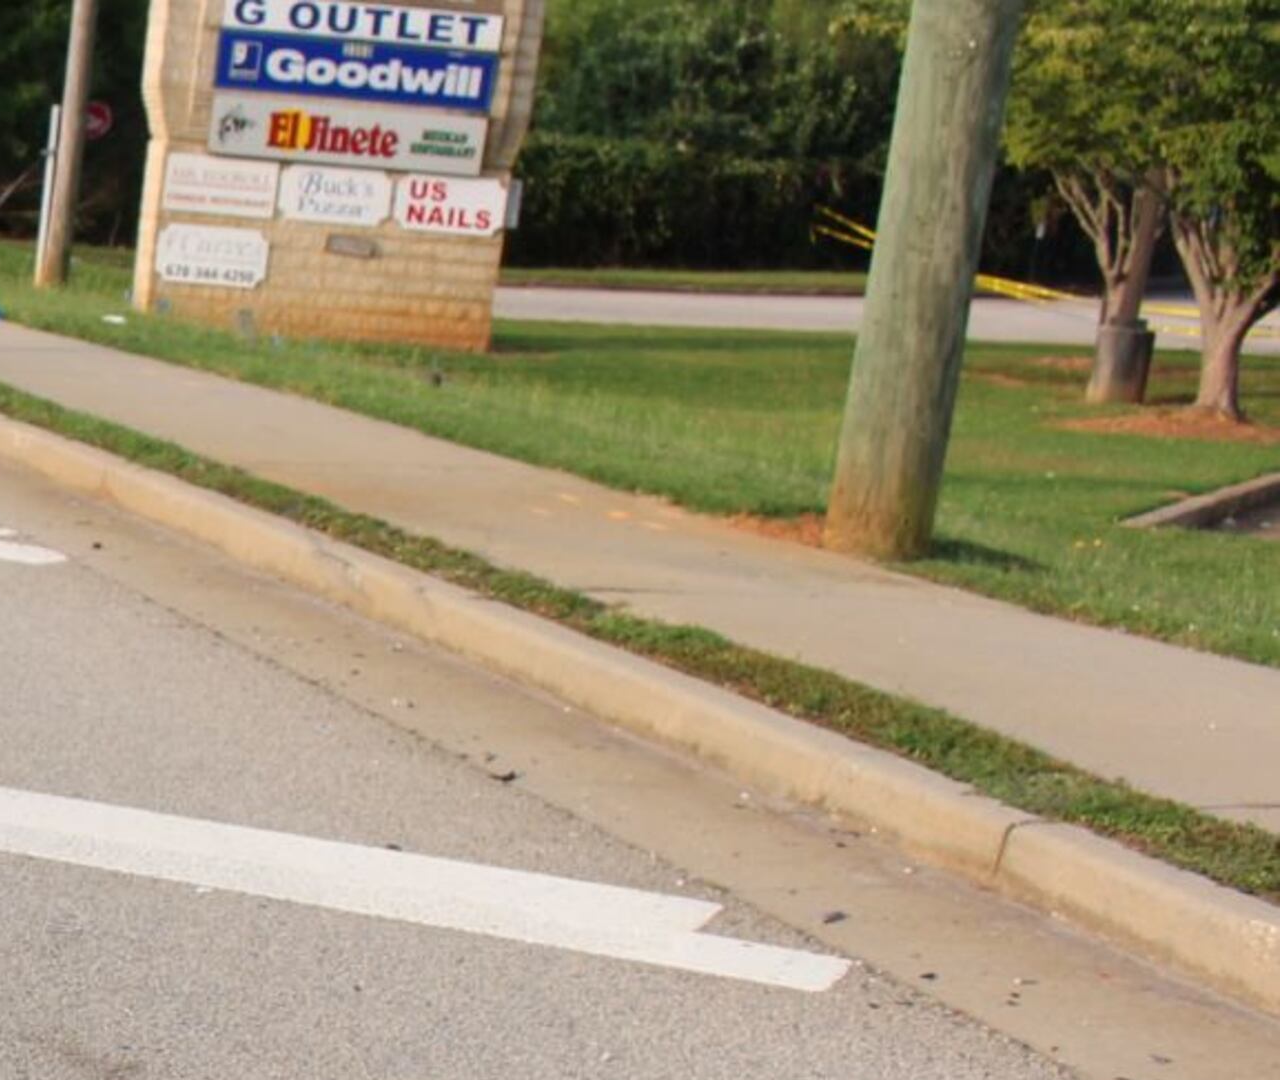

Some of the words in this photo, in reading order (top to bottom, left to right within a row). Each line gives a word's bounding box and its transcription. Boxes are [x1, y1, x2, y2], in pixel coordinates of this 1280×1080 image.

[289, 3, 488, 44] OUTLET
[266, 48, 482, 98] Goodwill
[266, 110, 303, 150] El
[302, 115, 399, 159] Jinete
[409, 179, 448, 201] US
[406, 204, 491, 230] NAILS
